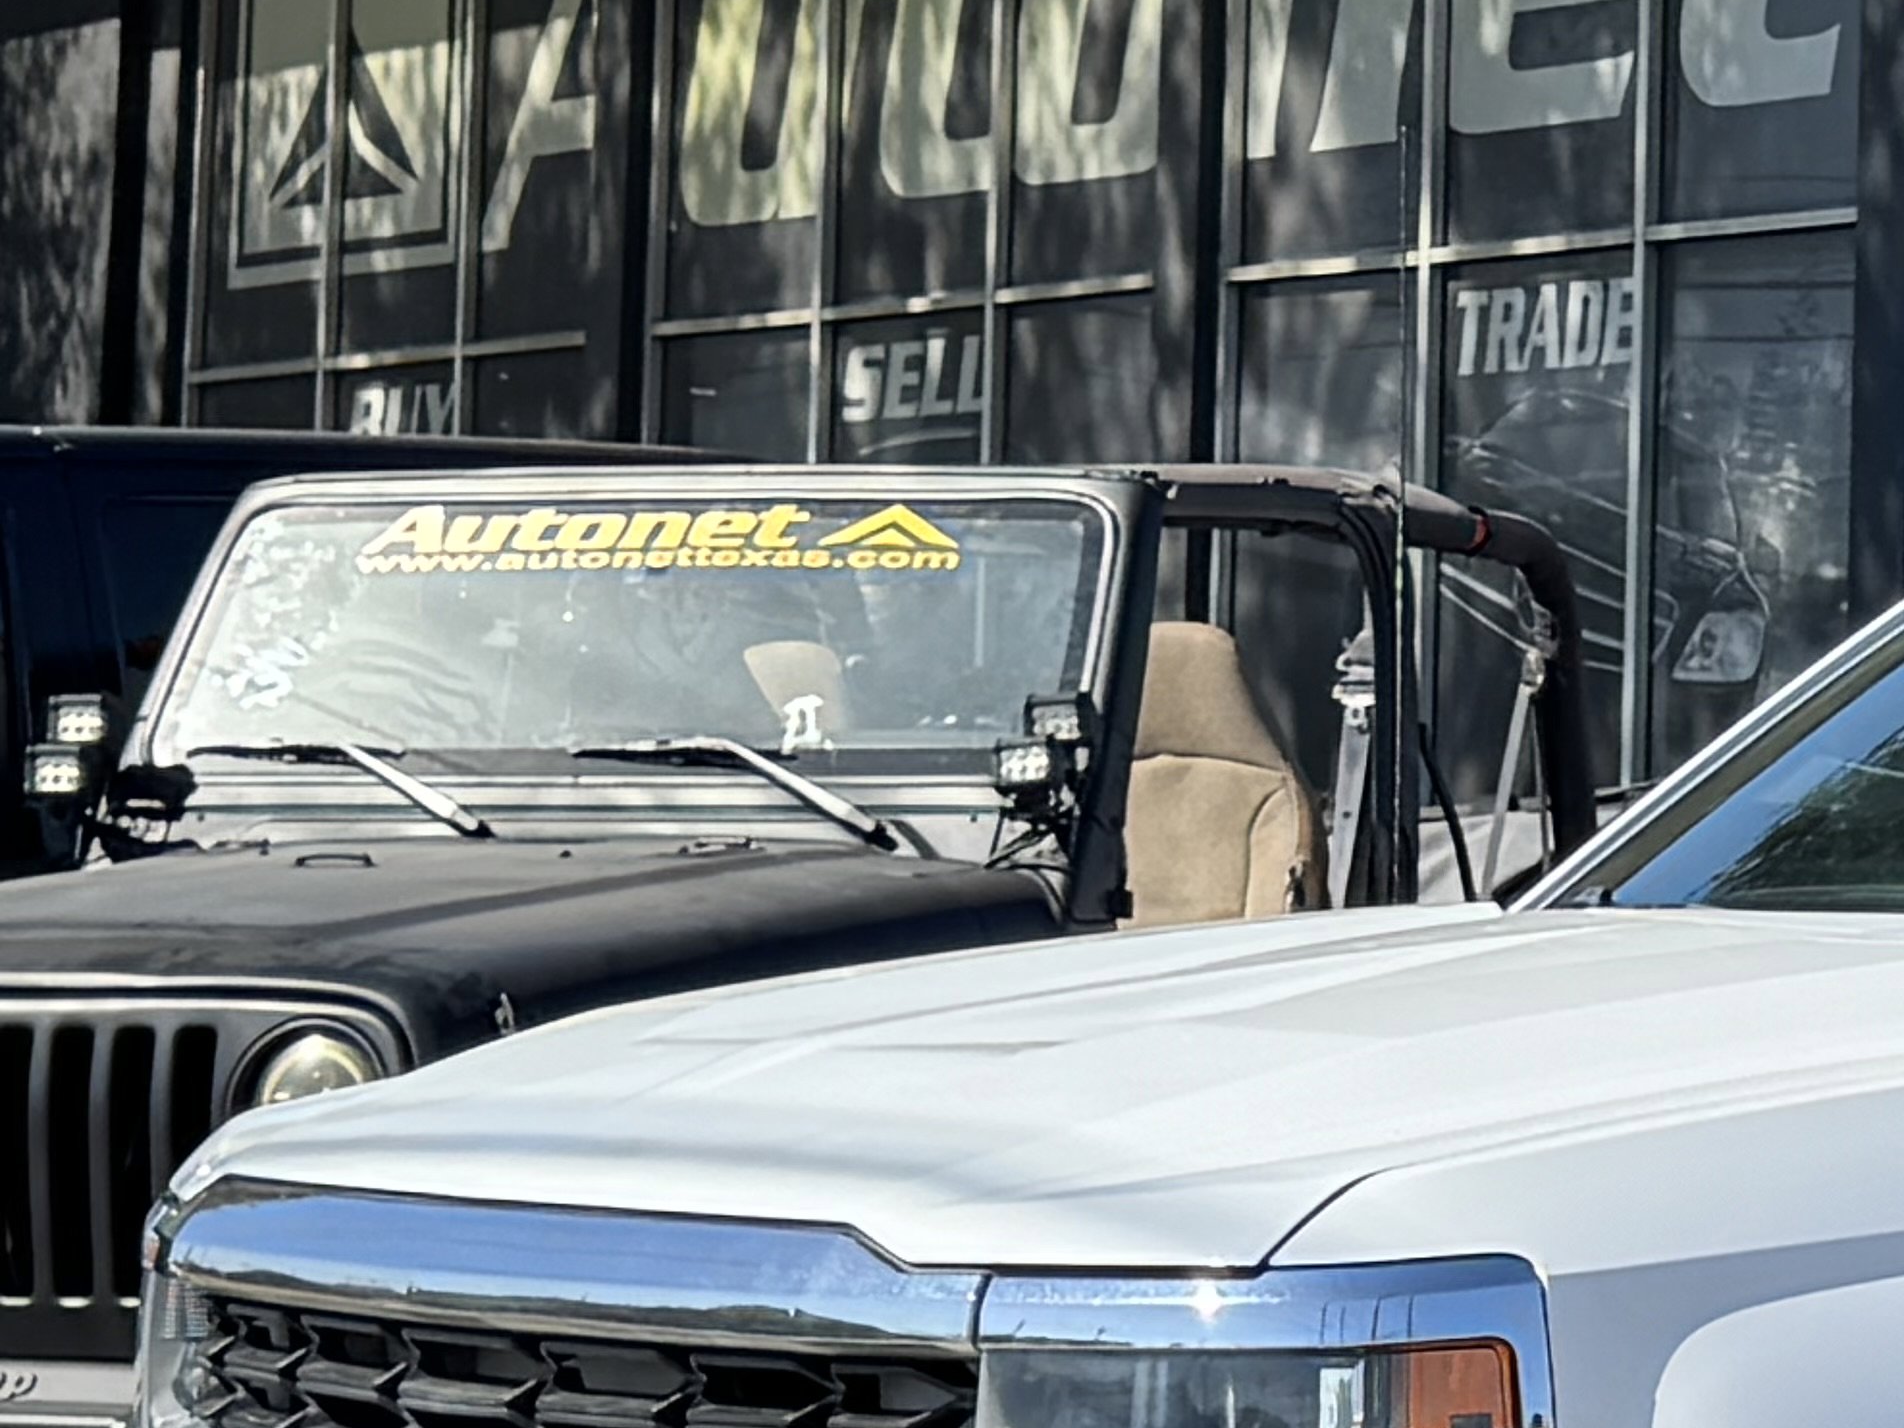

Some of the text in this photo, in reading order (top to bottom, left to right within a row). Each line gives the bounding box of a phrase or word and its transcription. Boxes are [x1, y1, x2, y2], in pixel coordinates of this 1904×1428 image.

[1456, 276, 1638, 376] TRADE
[841, 334, 985, 423] SELL
[360, 503, 811, 556] Autonet
